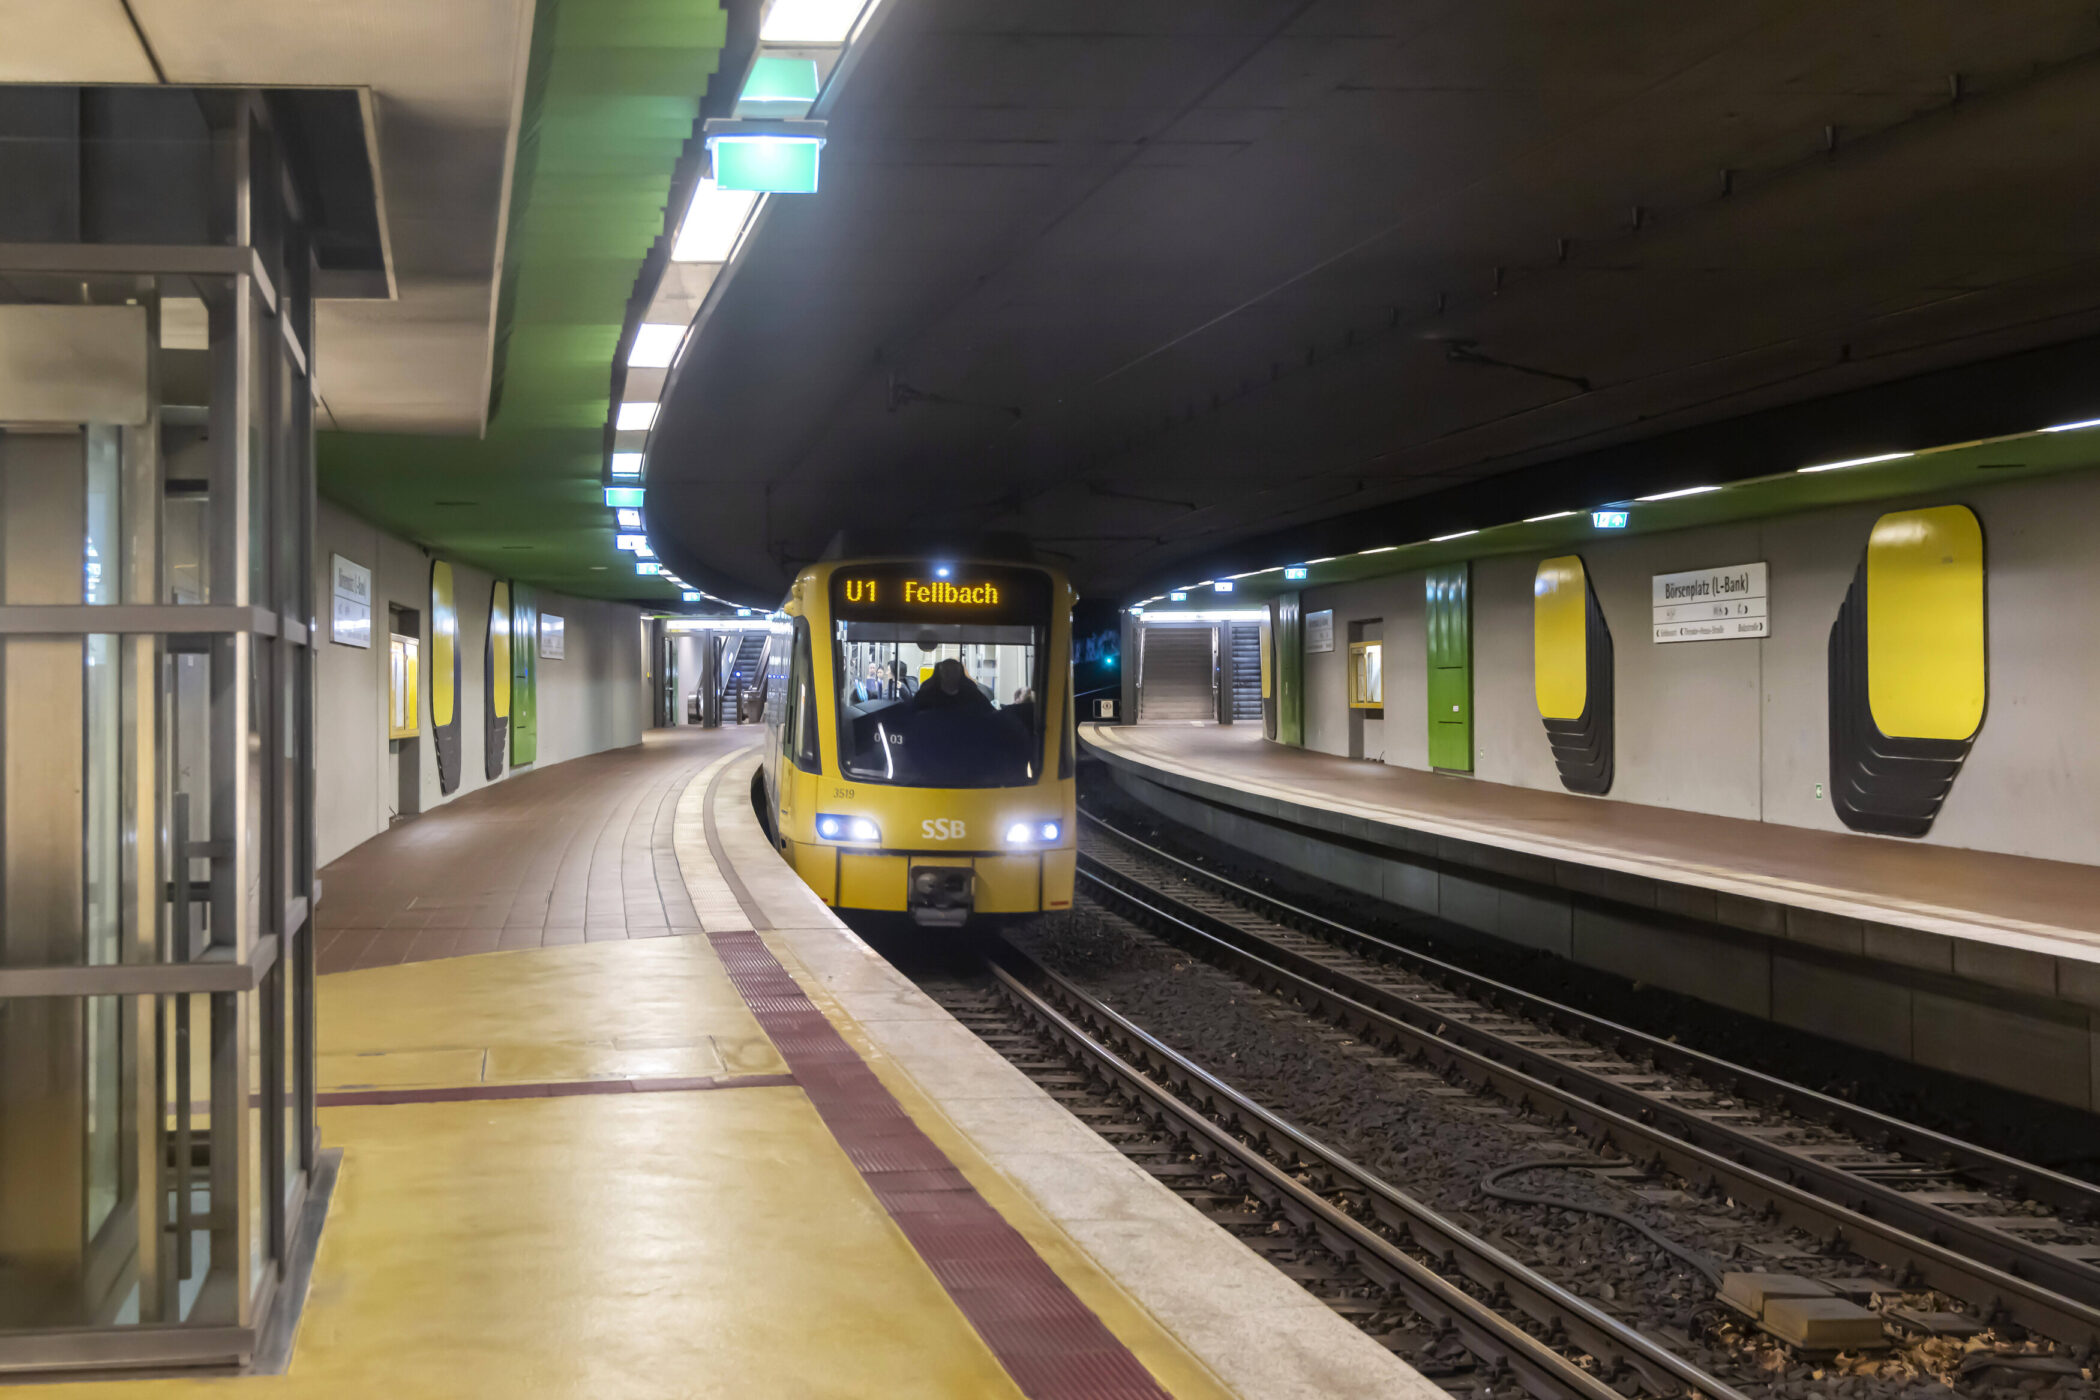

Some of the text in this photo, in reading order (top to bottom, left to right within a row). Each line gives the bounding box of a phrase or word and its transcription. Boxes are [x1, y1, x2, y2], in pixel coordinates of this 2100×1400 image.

[846, 580, 999, 604] U1 Fellbach
[1665, 572, 1749, 601] Börsenplatz (L-Bank)
[833, 787, 855, 799] 3519
[921, 818, 966, 841] SSB
